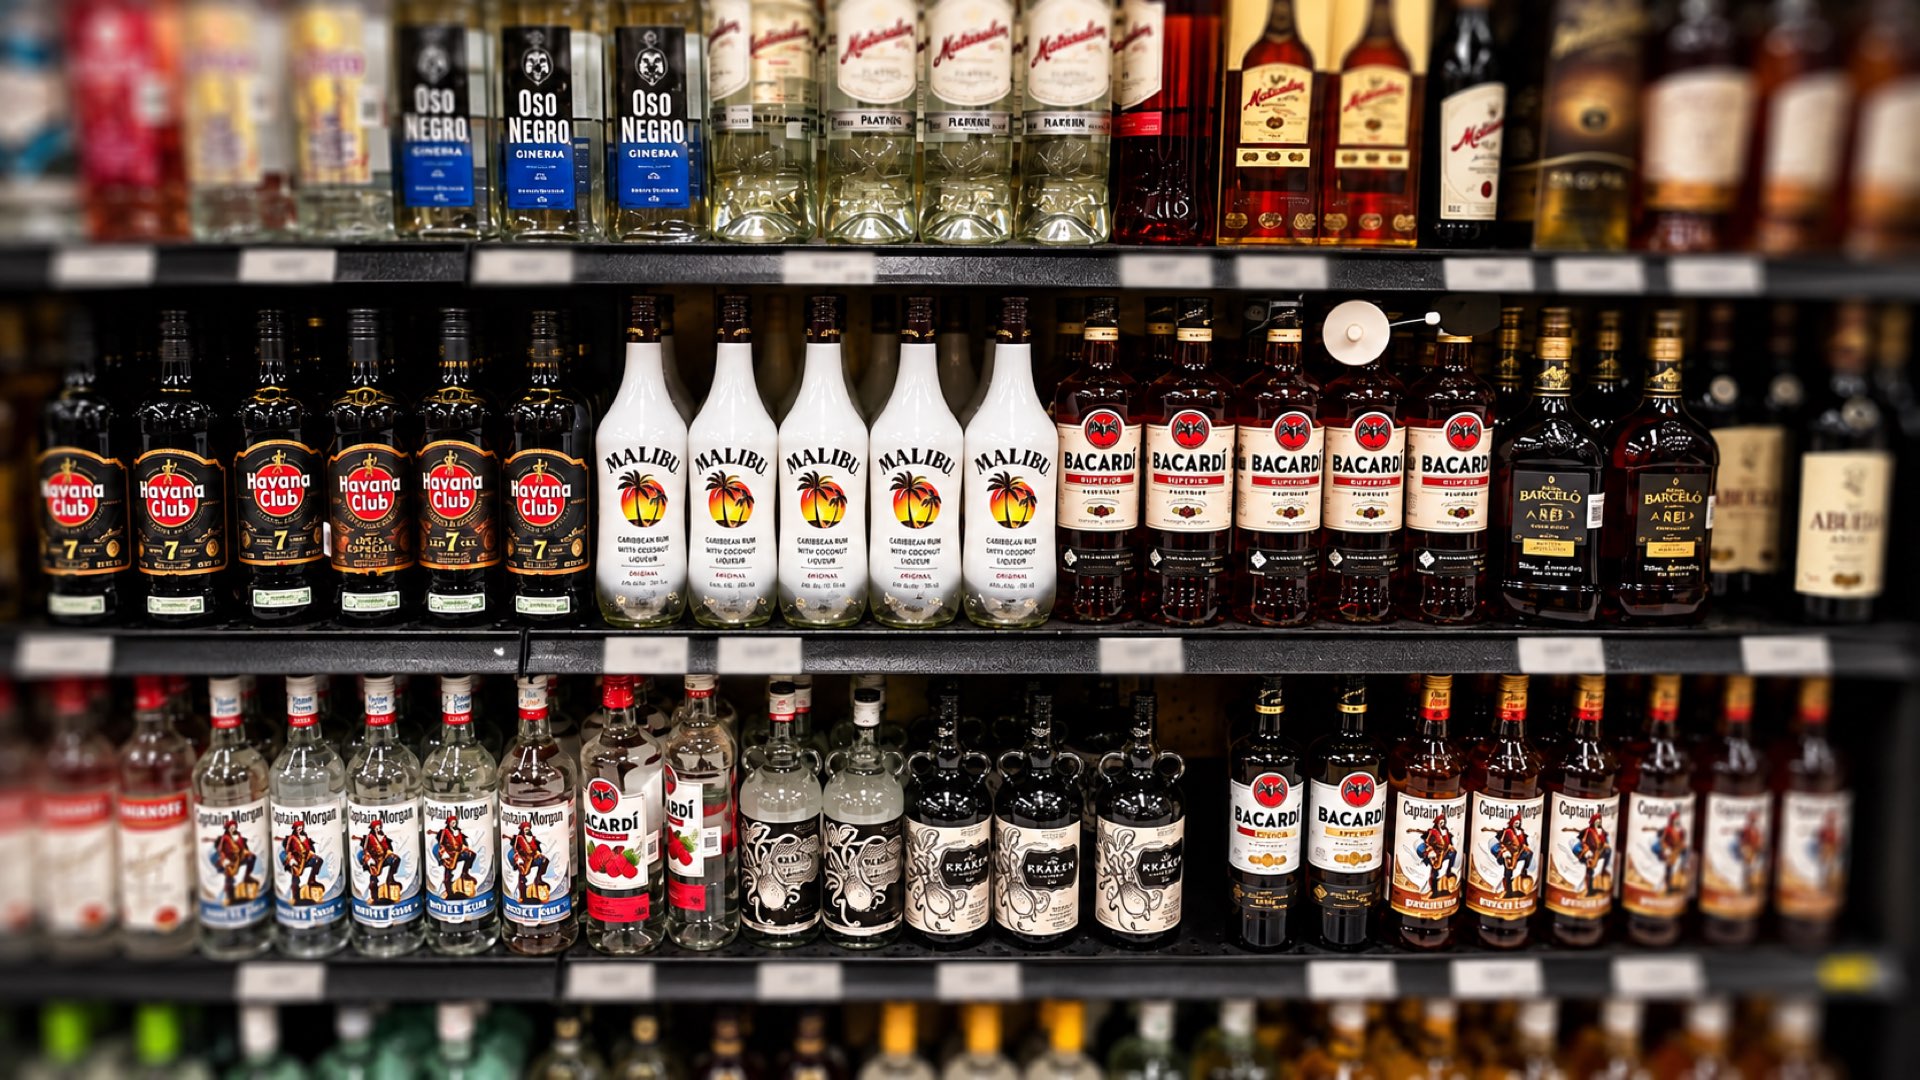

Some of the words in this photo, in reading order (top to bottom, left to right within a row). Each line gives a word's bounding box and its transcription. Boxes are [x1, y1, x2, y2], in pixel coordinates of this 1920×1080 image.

[406, 114, 467, 141] NEGRO
[509, 119, 569, 144] NEGRO
[621, 117, 684, 144] NEGRO
[605, 446, 681, 475] MALIBU
[695, 448, 768, 477] MALIBU
[786, 448, 861, 477] MALIBU
[879, 448, 956, 477] MALIBU
[974, 448, 1051, 477] MALIBU
[1065, 447, 1136, 471] BACARDÍ
[1153, 448, 1226, 472] BACARDÍ
[41, 481, 104, 498] Havana
[140, 481, 205, 499] Havana
[247, 473, 310, 490] Havana
[339, 475, 400, 492] Havana
[423, 473, 483, 490] Havana
[511, 480, 571, 498] Havana
[260, 490, 299, 507] Club
[351, 494, 389, 511] Club
[433, 492, 470, 509] Club
[522, 500, 557, 516] Club
[52, 500, 90, 517] Club
[151, 500, 190, 517] Club
[274, 530, 288, 550] 7
[446, 532, 460, 551] 7
[63, 540, 78, 560] 7
[164, 540, 179, 560] 7
[534, 540, 547, 560] 7
[300, 807, 336, 826] Morgan
[379, 806, 414, 824] Morgan
[454, 803, 488, 821] Morgan
[529, 809, 563, 827] Morgan
[667, 799, 693, 820] ARDÍ
[1235, 801, 1300, 828] BACARDÍ
[1319, 801, 1385, 828] BACARDÍ
[1403, 801, 1439, 819] Captain
[1479, 801, 1515, 818] Captain
[1559, 800, 1595, 818] Captain
[584, 811, 638, 833] ACARDÍ
